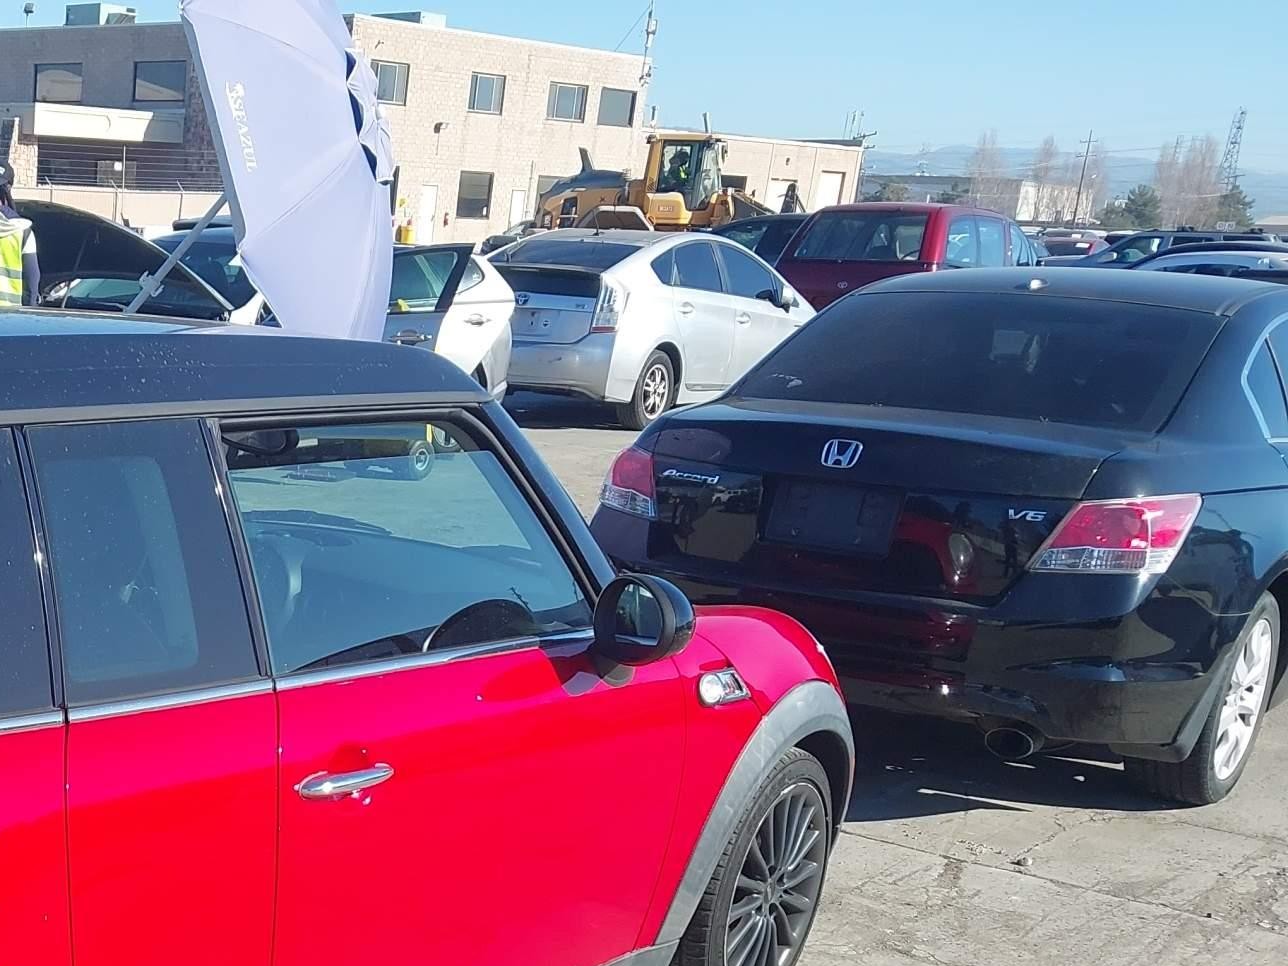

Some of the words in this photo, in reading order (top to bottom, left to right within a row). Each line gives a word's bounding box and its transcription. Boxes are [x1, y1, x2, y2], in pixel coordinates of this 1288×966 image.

[232, 95, 257, 173] SEAZUL
[662, 469, 720, 485] Accord
[1008, 508, 1048, 522] V6
